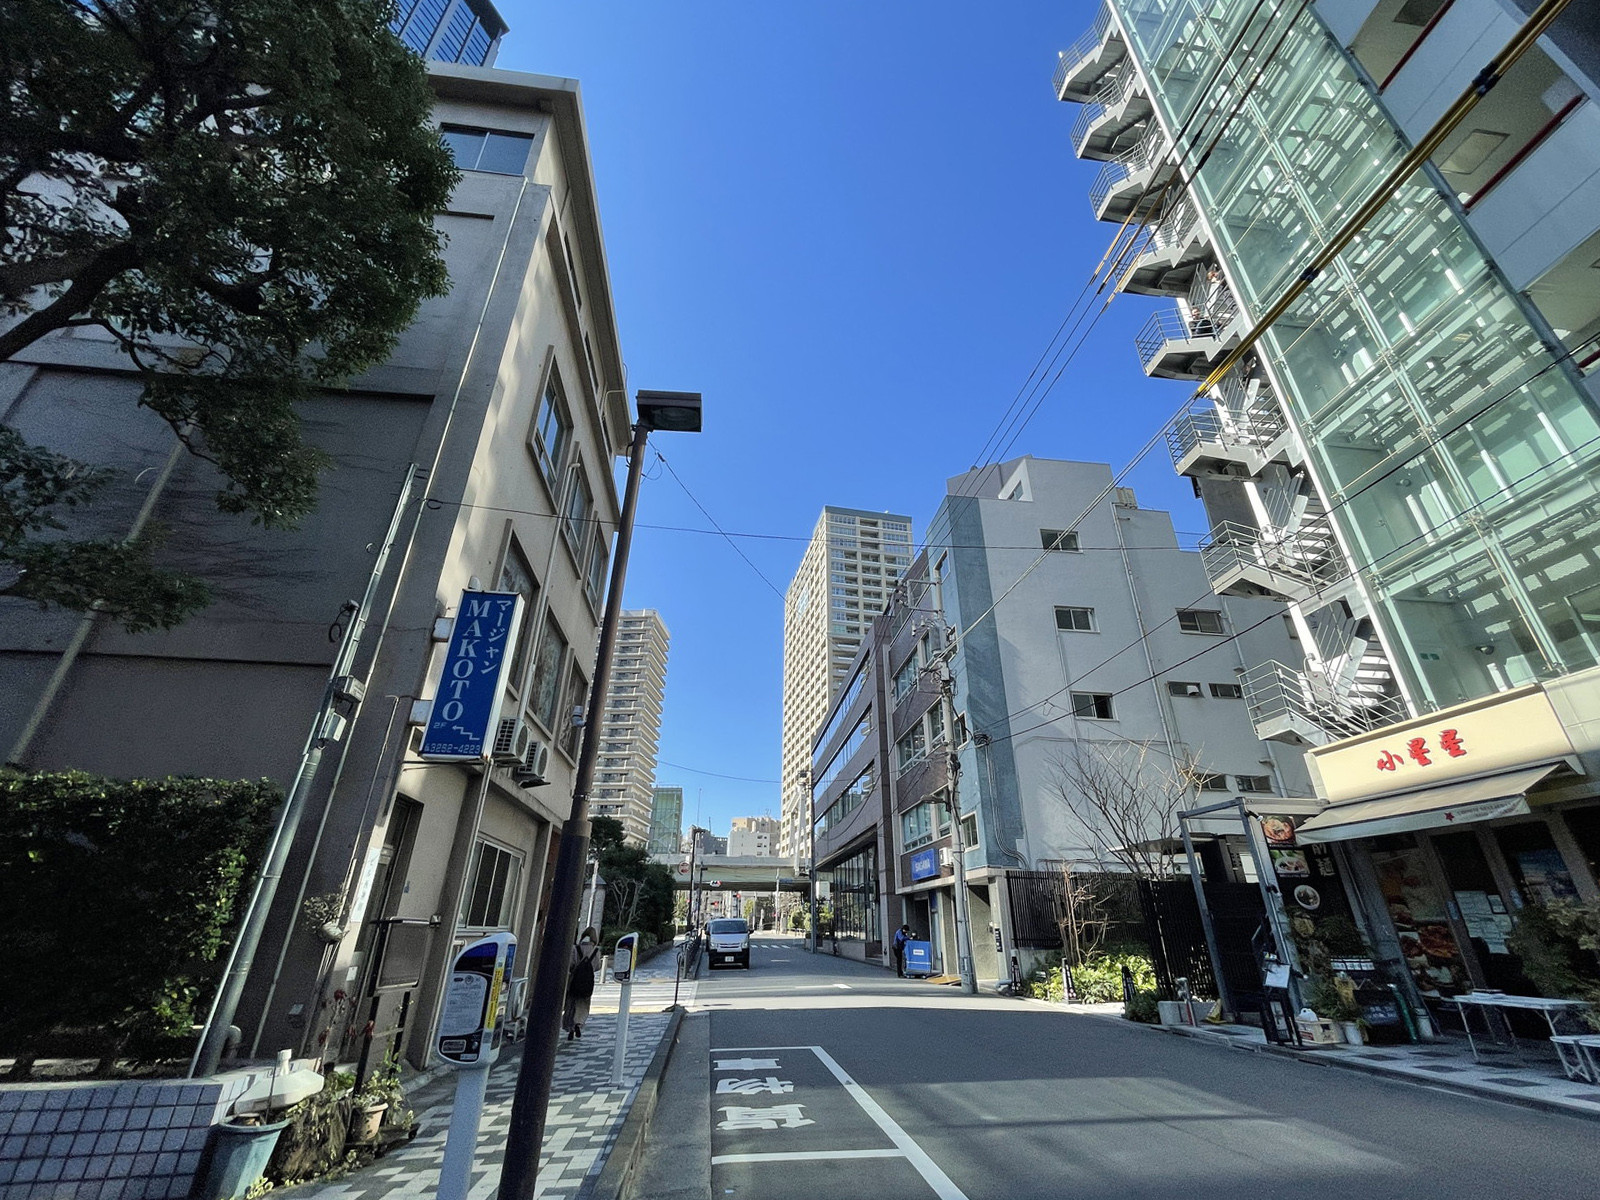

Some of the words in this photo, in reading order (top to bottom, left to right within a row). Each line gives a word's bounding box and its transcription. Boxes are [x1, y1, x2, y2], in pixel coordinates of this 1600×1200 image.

[442, 599, 491, 721] MAKOTO
[480, 599, 512, 675] マージャン
[1376, 728, 1468, 772] 小星星
